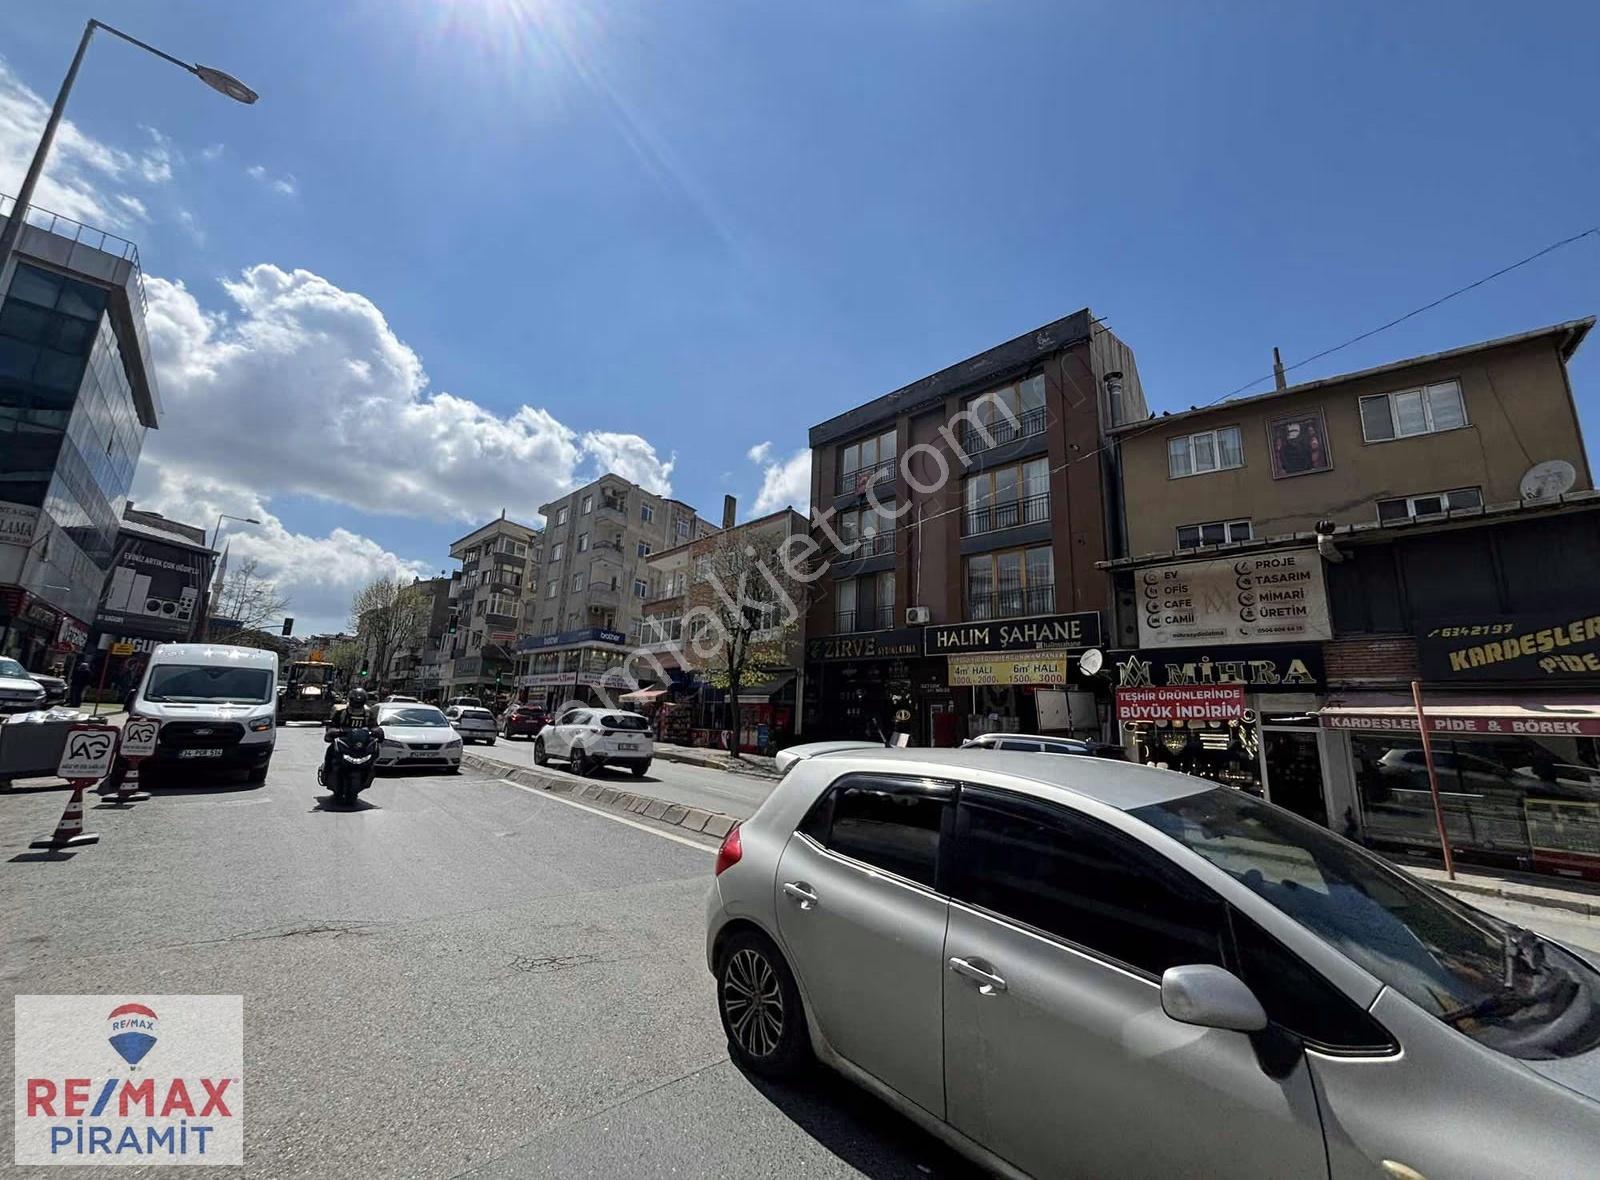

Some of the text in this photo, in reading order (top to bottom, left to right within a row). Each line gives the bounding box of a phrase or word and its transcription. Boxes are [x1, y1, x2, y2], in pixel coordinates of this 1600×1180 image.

[145, 557, 163, 567] ARTIK
[1255, 557, 1295, 569] PROJE
[1164, 571, 1178, 580] EV
[1255, 571, 1311, 584] TASARIM
[1164, 585, 1189, 595] OFİS
[1259, 590, 1305, 602] MİMARİ
[1164, 599, 1192, 609] CAFE
[1260, 605, 1307, 618] ÜRETİM
[600, 632, 620, 641] brother
[937, 620, 1082, 648] HALIM ŞAHANE
[824, 637, 876, 658] ZİRVE
[972, 666, 992, 675] HALI
[1034, 664, 1058, 673] HALI
[1165, 656, 1317, 686] MİHRA
[1119, 689, 1240, 703] TEŞHİR ÜRÜNLERİNDE
[1120, 702, 1241, 719] BÜYÜK İNDİRİM
[1435, 717, 1477, 731] PİDE
[1488, 719, 1502, 732] &
[1512, 719, 1582, 734] BÖREK
